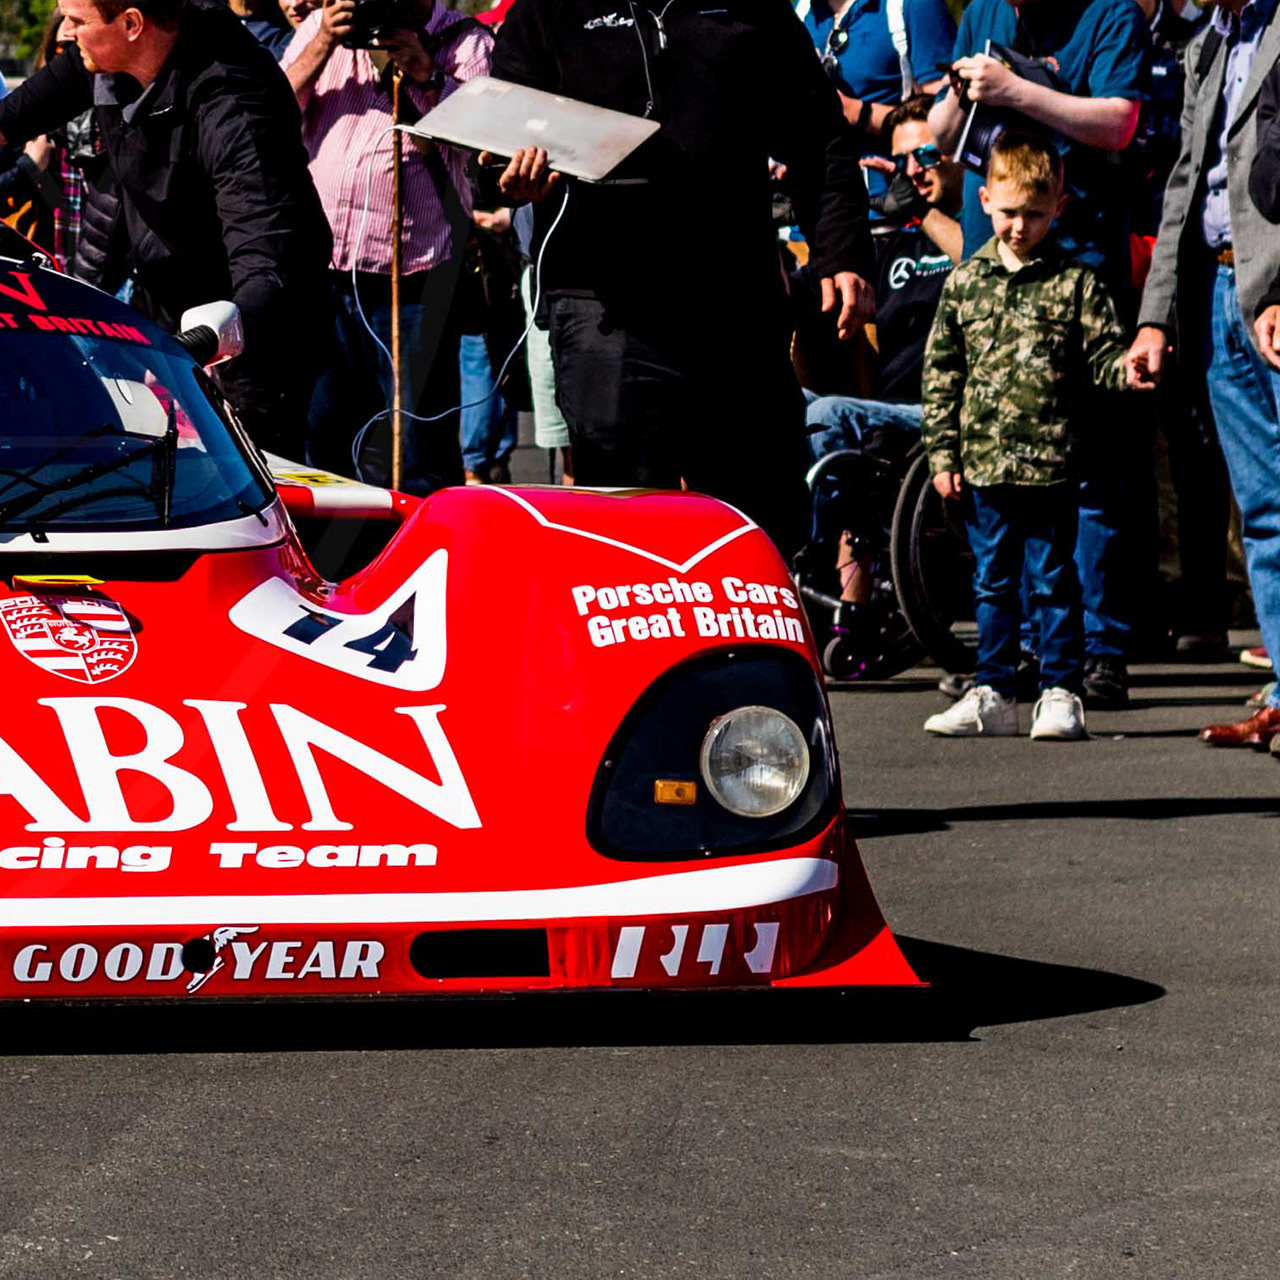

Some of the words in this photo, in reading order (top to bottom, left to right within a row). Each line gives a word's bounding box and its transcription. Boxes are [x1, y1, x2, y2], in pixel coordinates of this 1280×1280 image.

[27, 314, 152, 346] BRITAIN
[571, 577, 714, 616] Porsche
[721, 576, 799, 609] Cars
[282, 590, 419, 674] 14
[587, 607, 686, 648] Great
[692, 606, 804, 644] Britain
[208, 842, 439, 869] Team
